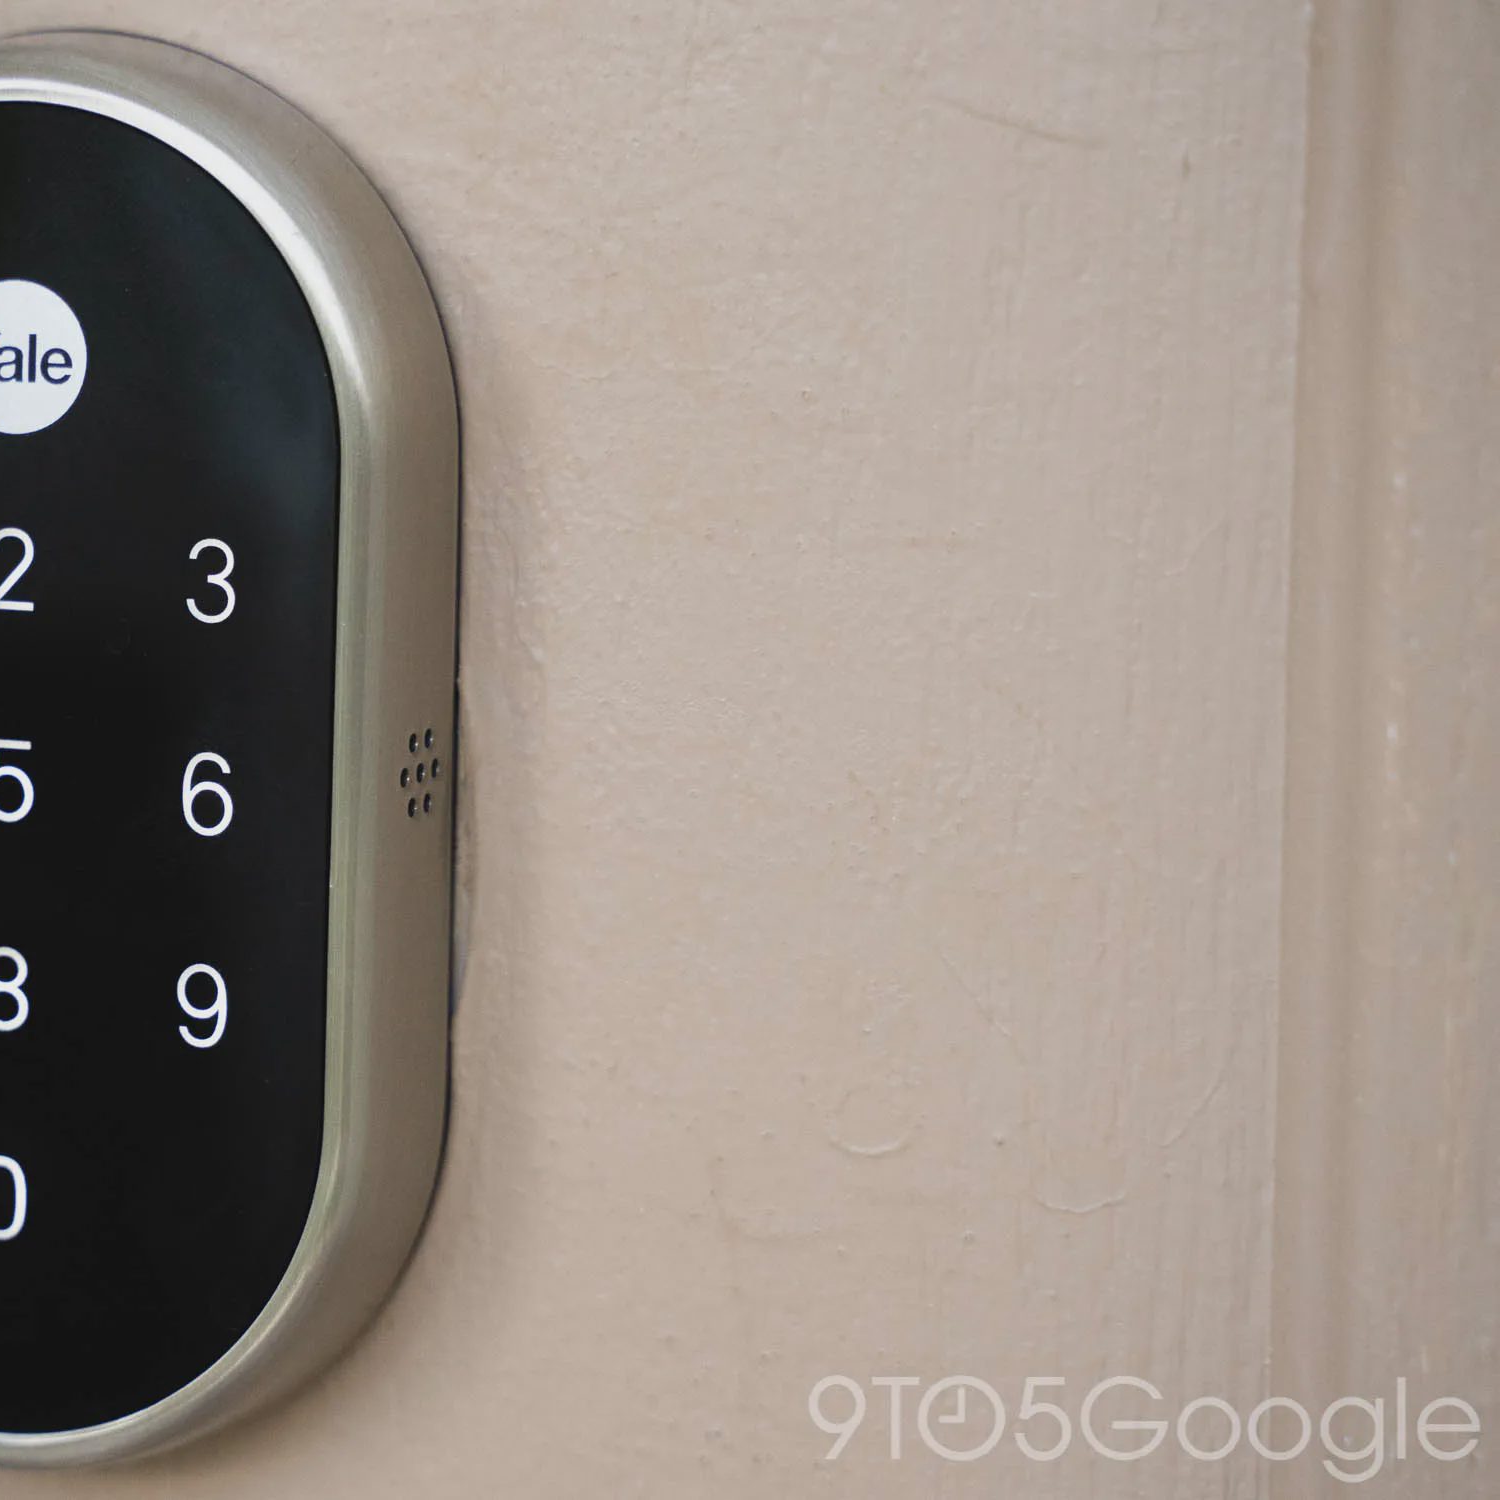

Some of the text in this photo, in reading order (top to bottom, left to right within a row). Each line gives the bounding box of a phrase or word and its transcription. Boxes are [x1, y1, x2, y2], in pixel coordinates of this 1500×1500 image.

[185, 537, 236, 624] 3
[181, 751, 234, 837] 6
[176, 963, 228, 1049] 9
